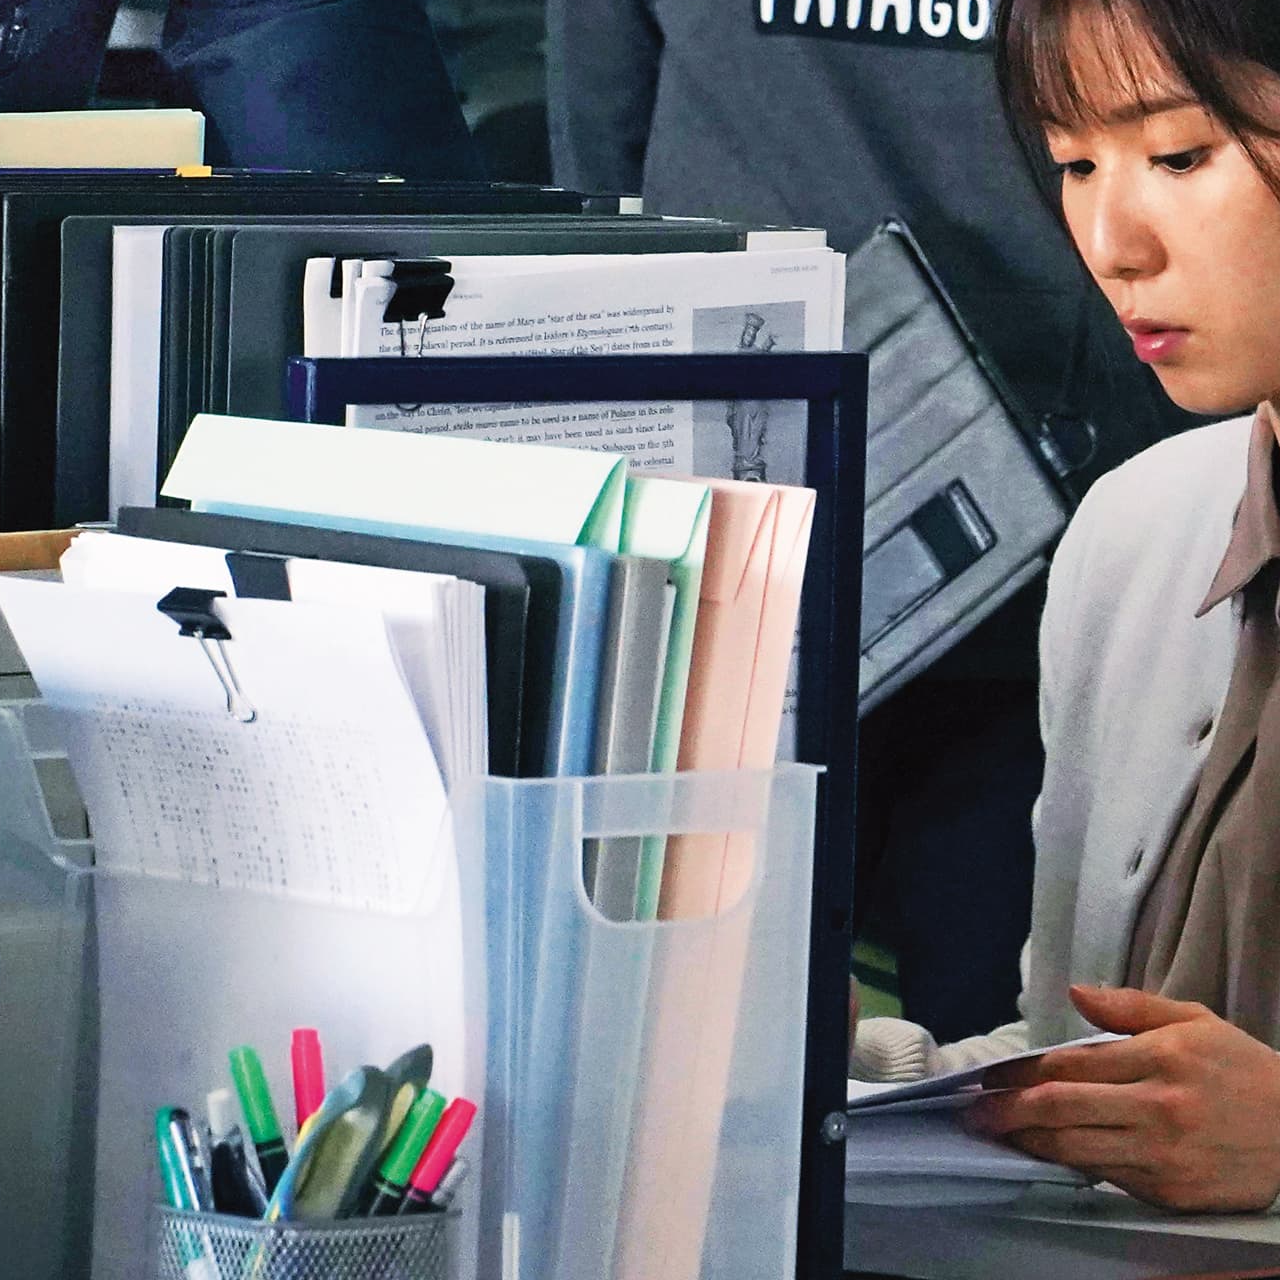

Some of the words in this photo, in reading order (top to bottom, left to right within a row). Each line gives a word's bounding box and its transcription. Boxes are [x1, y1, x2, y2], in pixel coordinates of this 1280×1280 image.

[470, 320, 482, 331] the
[517, 315, 535, 328] Mary
[566, 312, 575, 322] of
[575, 311, 587, 321] the
[607, 310, 621, 319] was
[623, 304, 664, 318] widespread
[666, 304, 675, 315] by
[633, 339, 651, 350] from
[662, 337, 674, 348] the
[521, 417, 530, 425] to
[531, 415, 541, 425] be
[542, 414, 560, 424] used
[578, 413, 600, 422] name
[601, 410, 609, 420] of
[638, 408, 647, 417] in
[544, 431, 563, 442] have
[564, 429, 583, 439] been
[585, 427, 603, 438] used
[615, 425, 634, 435] such
[635, 424, 656, 434] since
